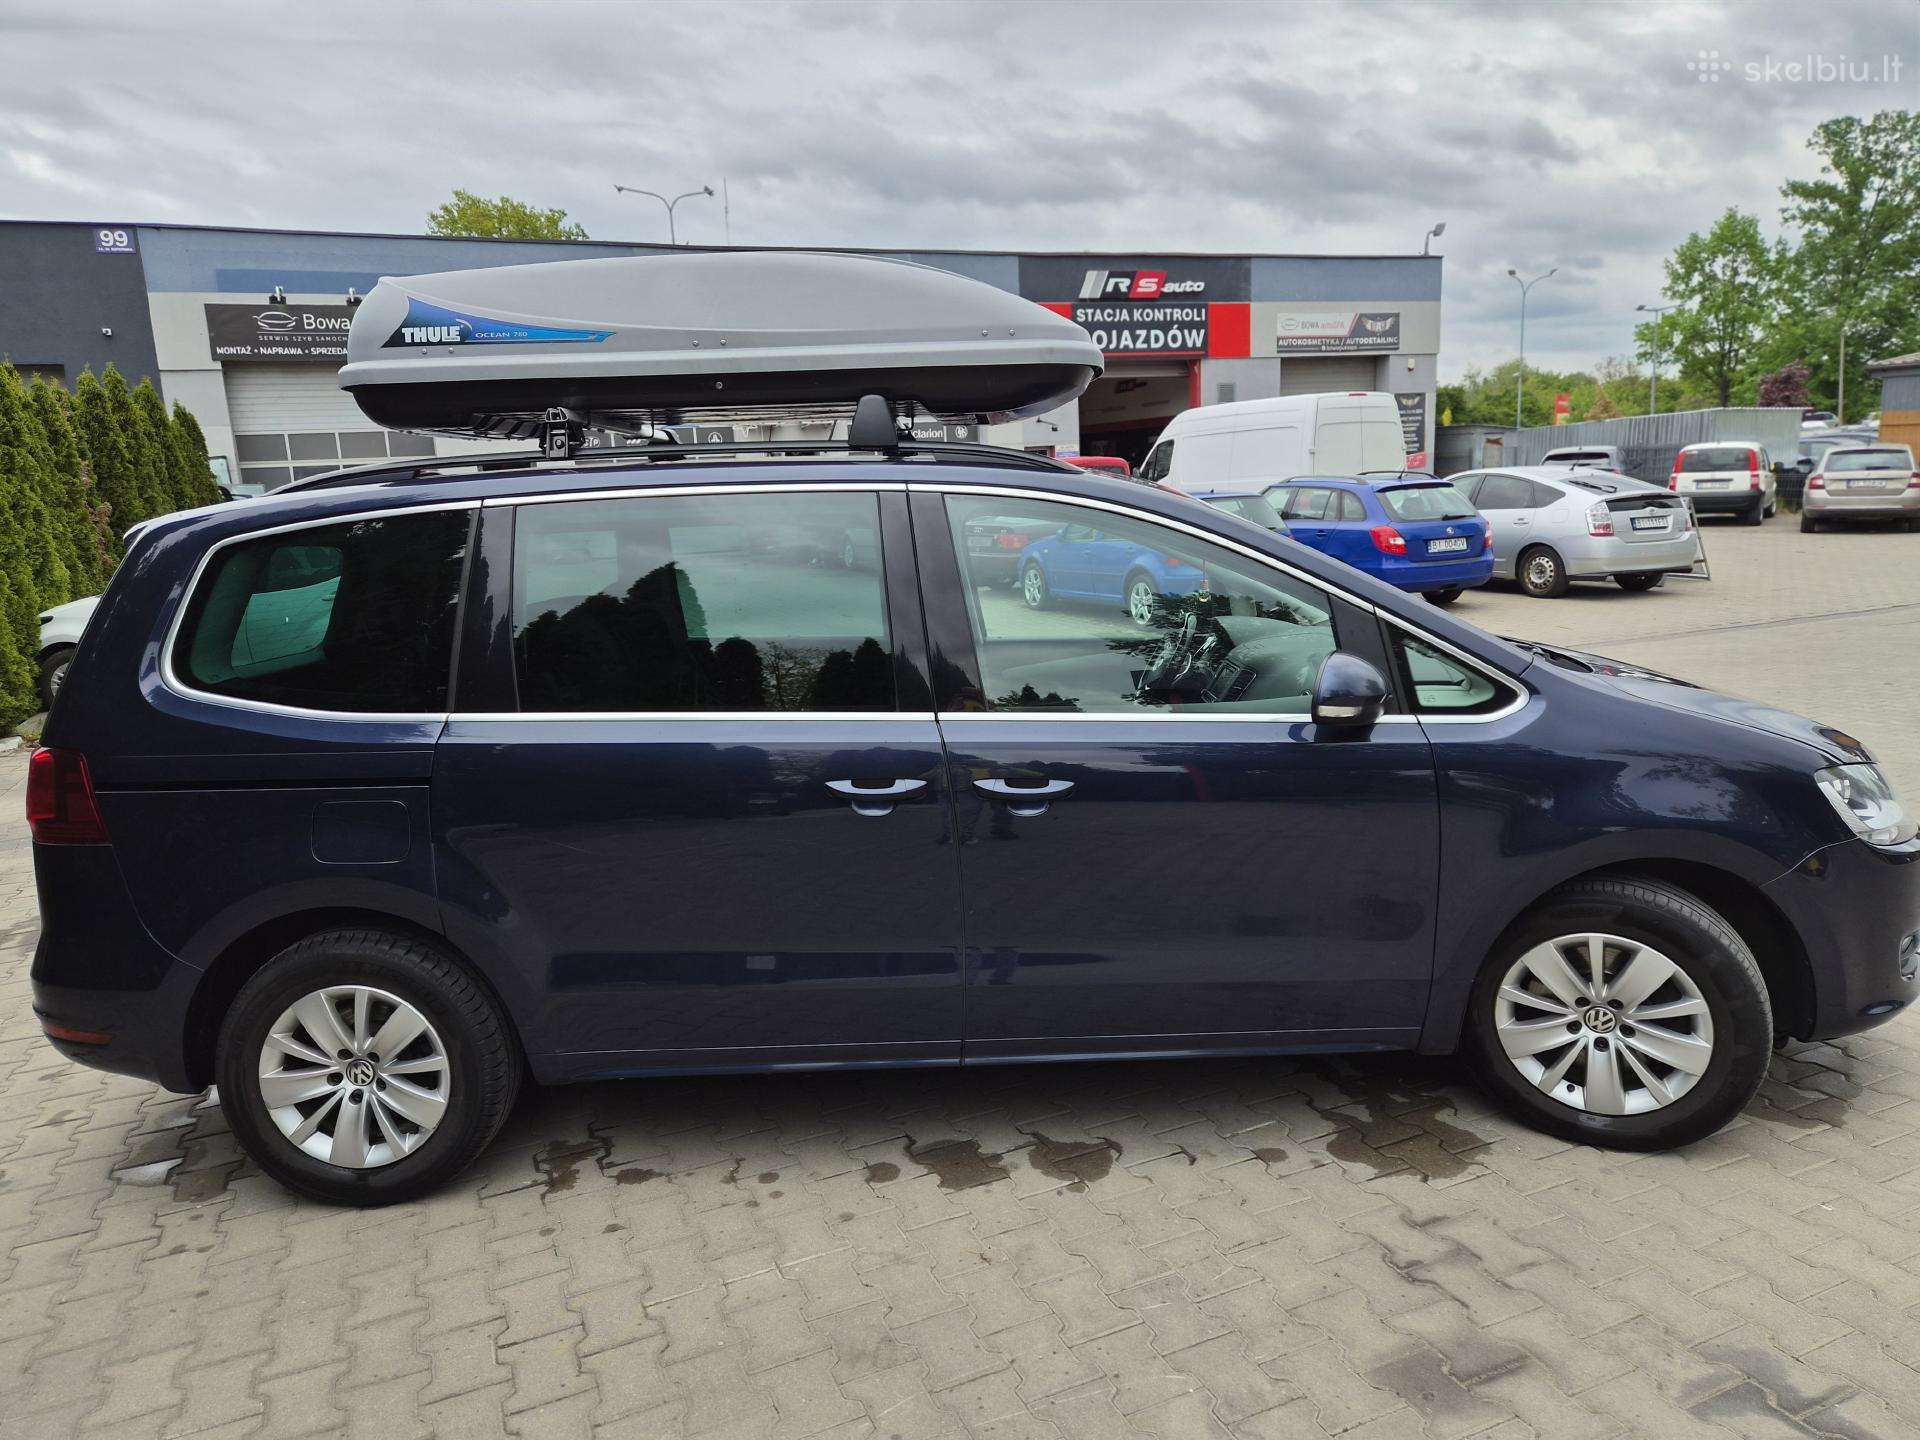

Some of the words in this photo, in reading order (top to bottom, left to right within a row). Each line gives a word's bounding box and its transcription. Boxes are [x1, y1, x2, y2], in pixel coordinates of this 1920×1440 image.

[100, 230, 128, 247] 99
[1161, 280, 1205, 293] auto
[1076, 308, 1129, 322] STACJA
[1133, 308, 1206, 321] KONTROLI
[402, 325, 461, 343] THULE
[1091, 324, 1205, 350] OJAZDÓW
[216, 345, 252, 355] MONTAŻ
[260, 346, 303, 355] NAPRAWA
[310, 346, 348, 355] SPRZEDA
[911, 428, 943, 439] clarion
